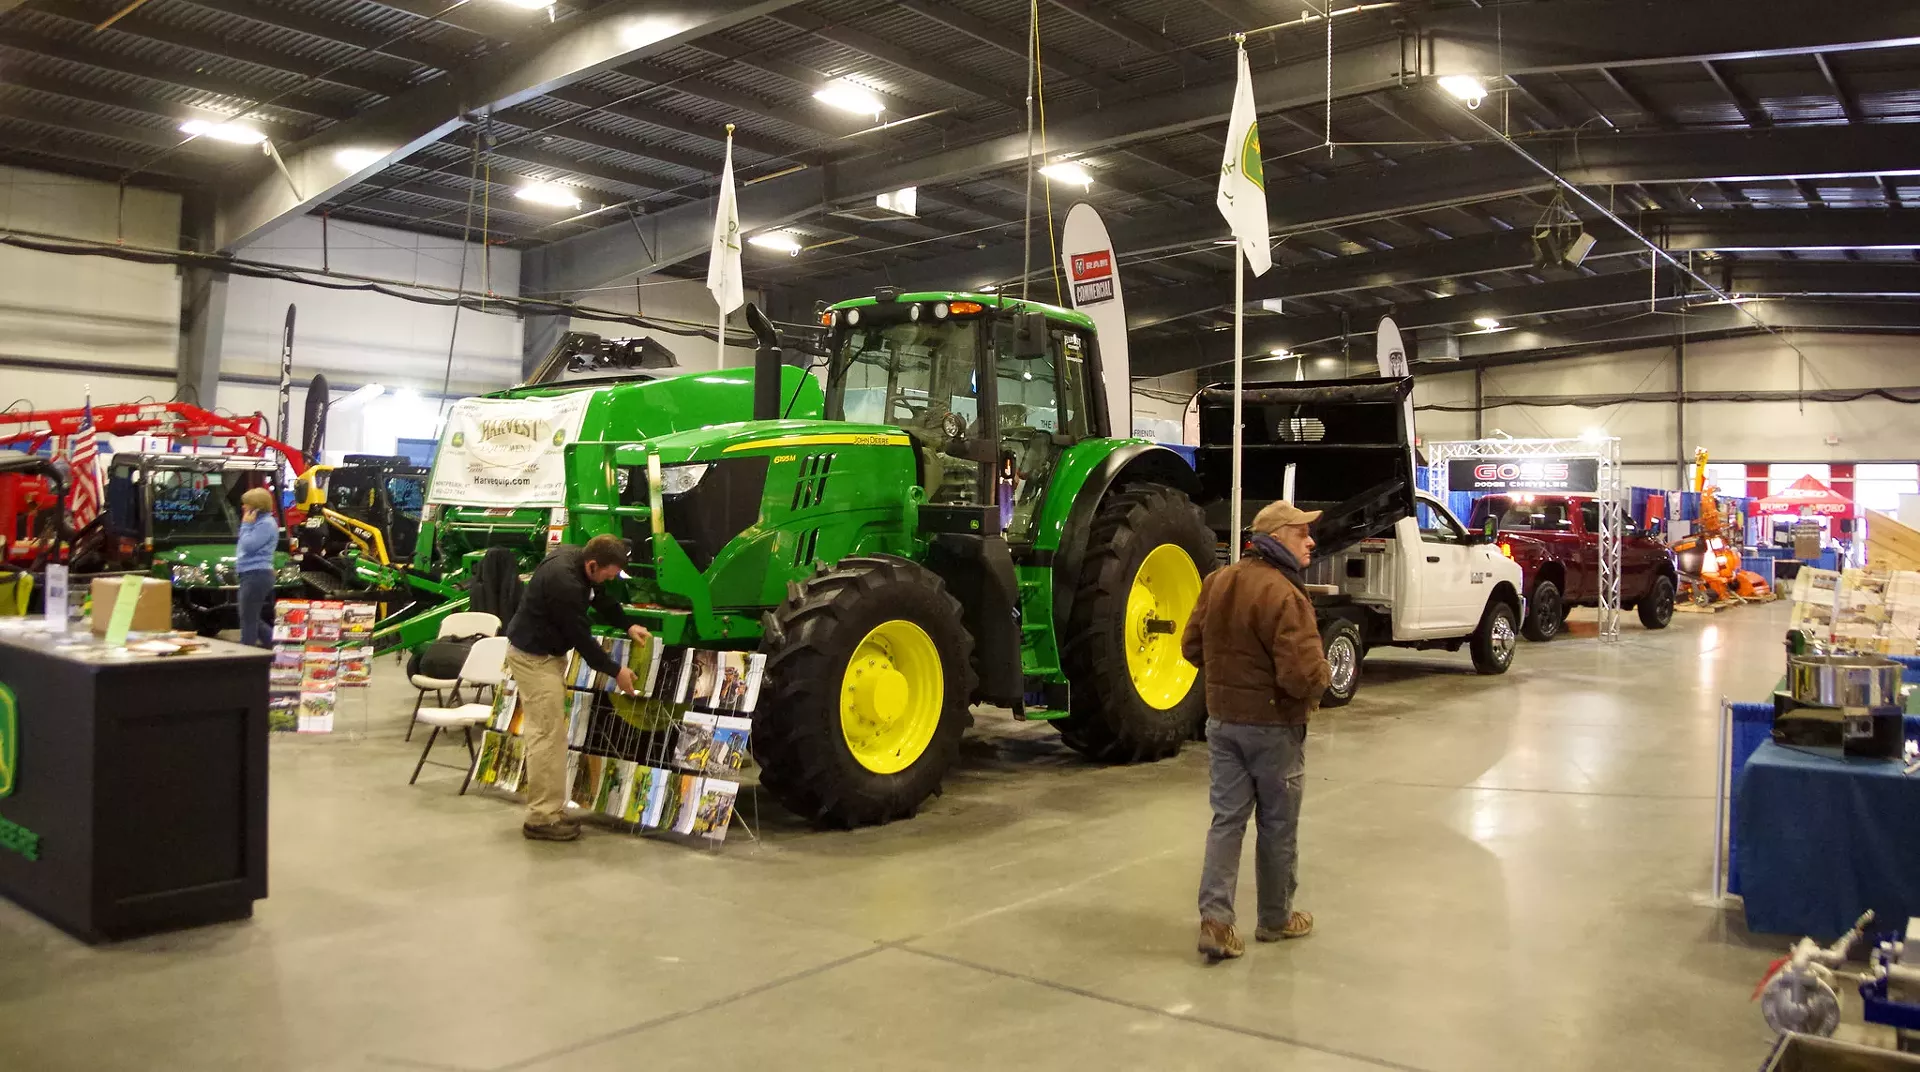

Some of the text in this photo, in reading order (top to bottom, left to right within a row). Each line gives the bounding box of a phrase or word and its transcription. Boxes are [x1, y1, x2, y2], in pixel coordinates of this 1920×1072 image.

[1085, 259, 1109, 270] RAM
[1076, 280, 1112, 303] COMMERCIAL
[479, 418, 538, 443] HARVEST
[853, 436, 889, 444] JOHN DEERE
[774, 455, 797, 464] 6195M
[1474, 463, 1569, 480] GOSS
[474, 475, 531, 487] Harvequip.com
